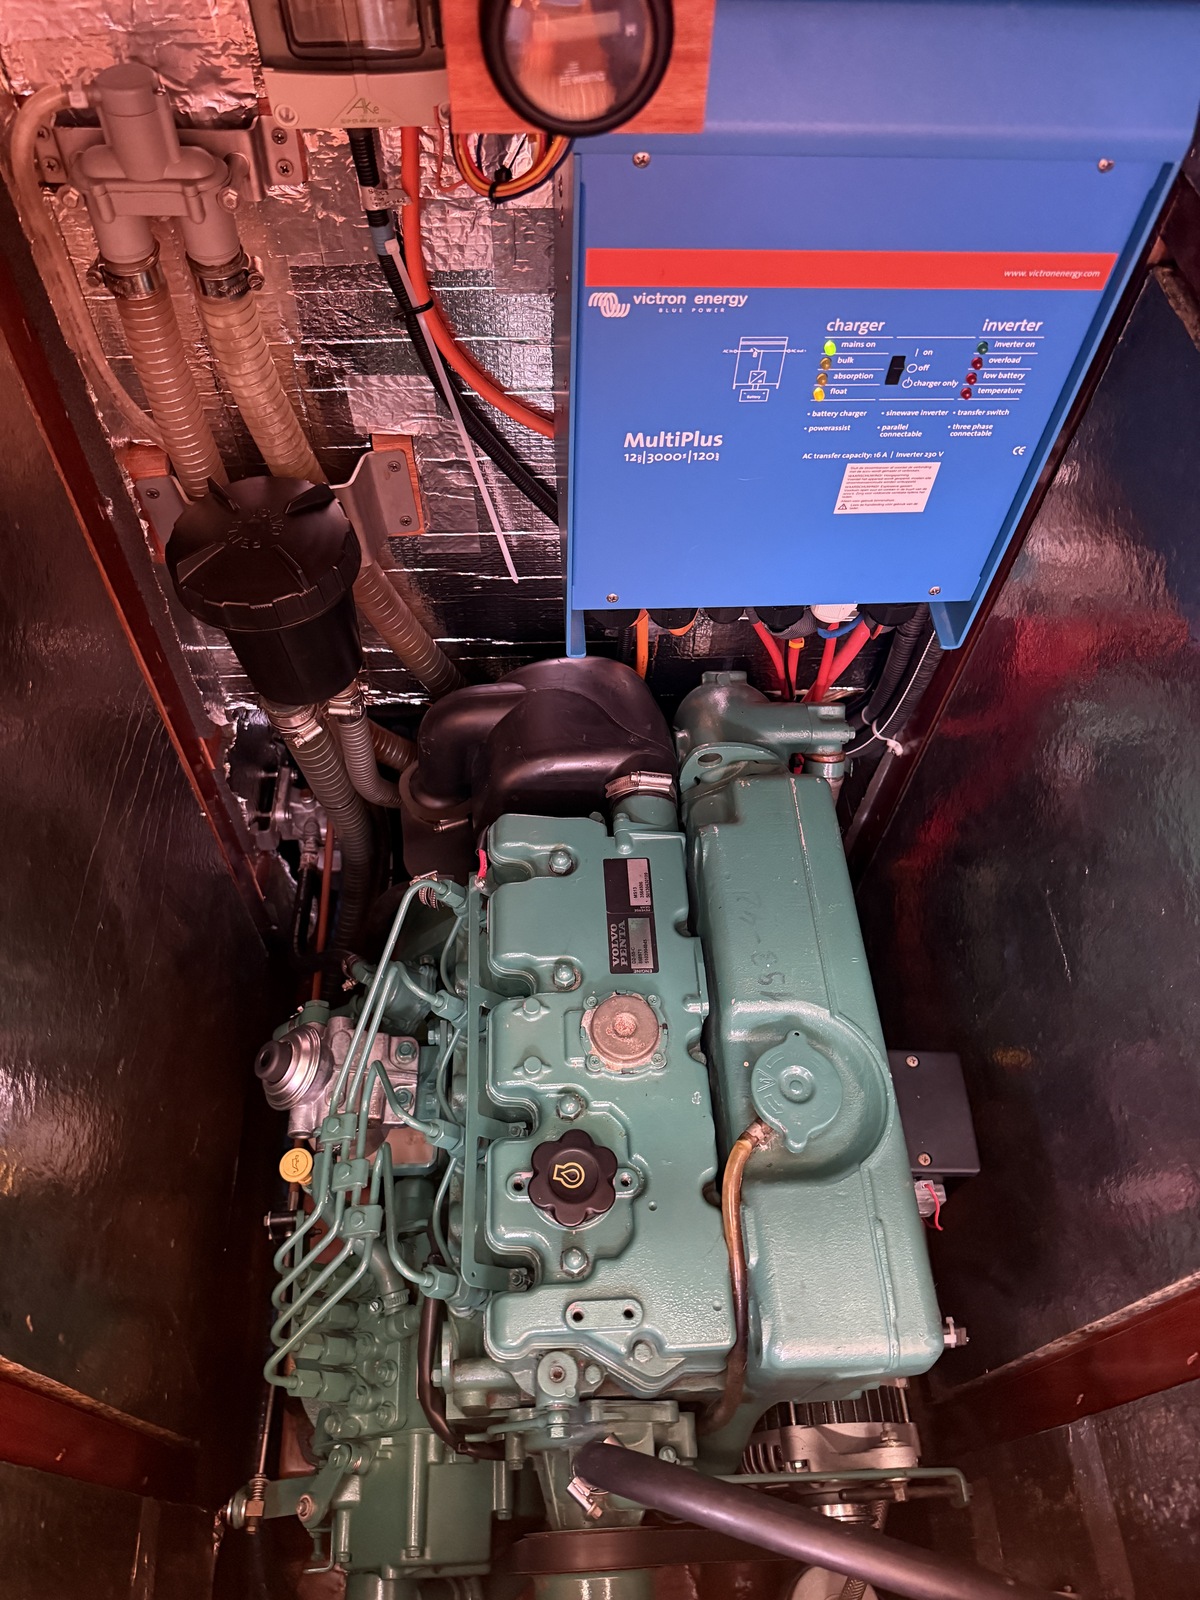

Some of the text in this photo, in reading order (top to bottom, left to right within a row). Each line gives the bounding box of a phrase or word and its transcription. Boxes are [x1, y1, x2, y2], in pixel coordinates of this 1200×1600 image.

[1028, 270, 1101, 279] victronenergy.com
[633, 292, 748, 307] victron energy
[826, 318, 885, 336] charger
[982, 318, 1043, 332] inverter
[988, 356, 1021, 364] overload
[998, 372, 1025, 381] battery
[913, 380, 959, 388] charger only
[977, 387, 1023, 395] temperature
[812, 410, 867, 418] battery charger
[808, 424, 851, 433] powerassist
[624, 430, 723, 448] MultiPlus
[1012, 446, 1027, 455] CE
[842, 451, 872, 460] capacity:
[610, 923, 620, 967] VOLVO
[618, 919, 628, 967] PENTA
